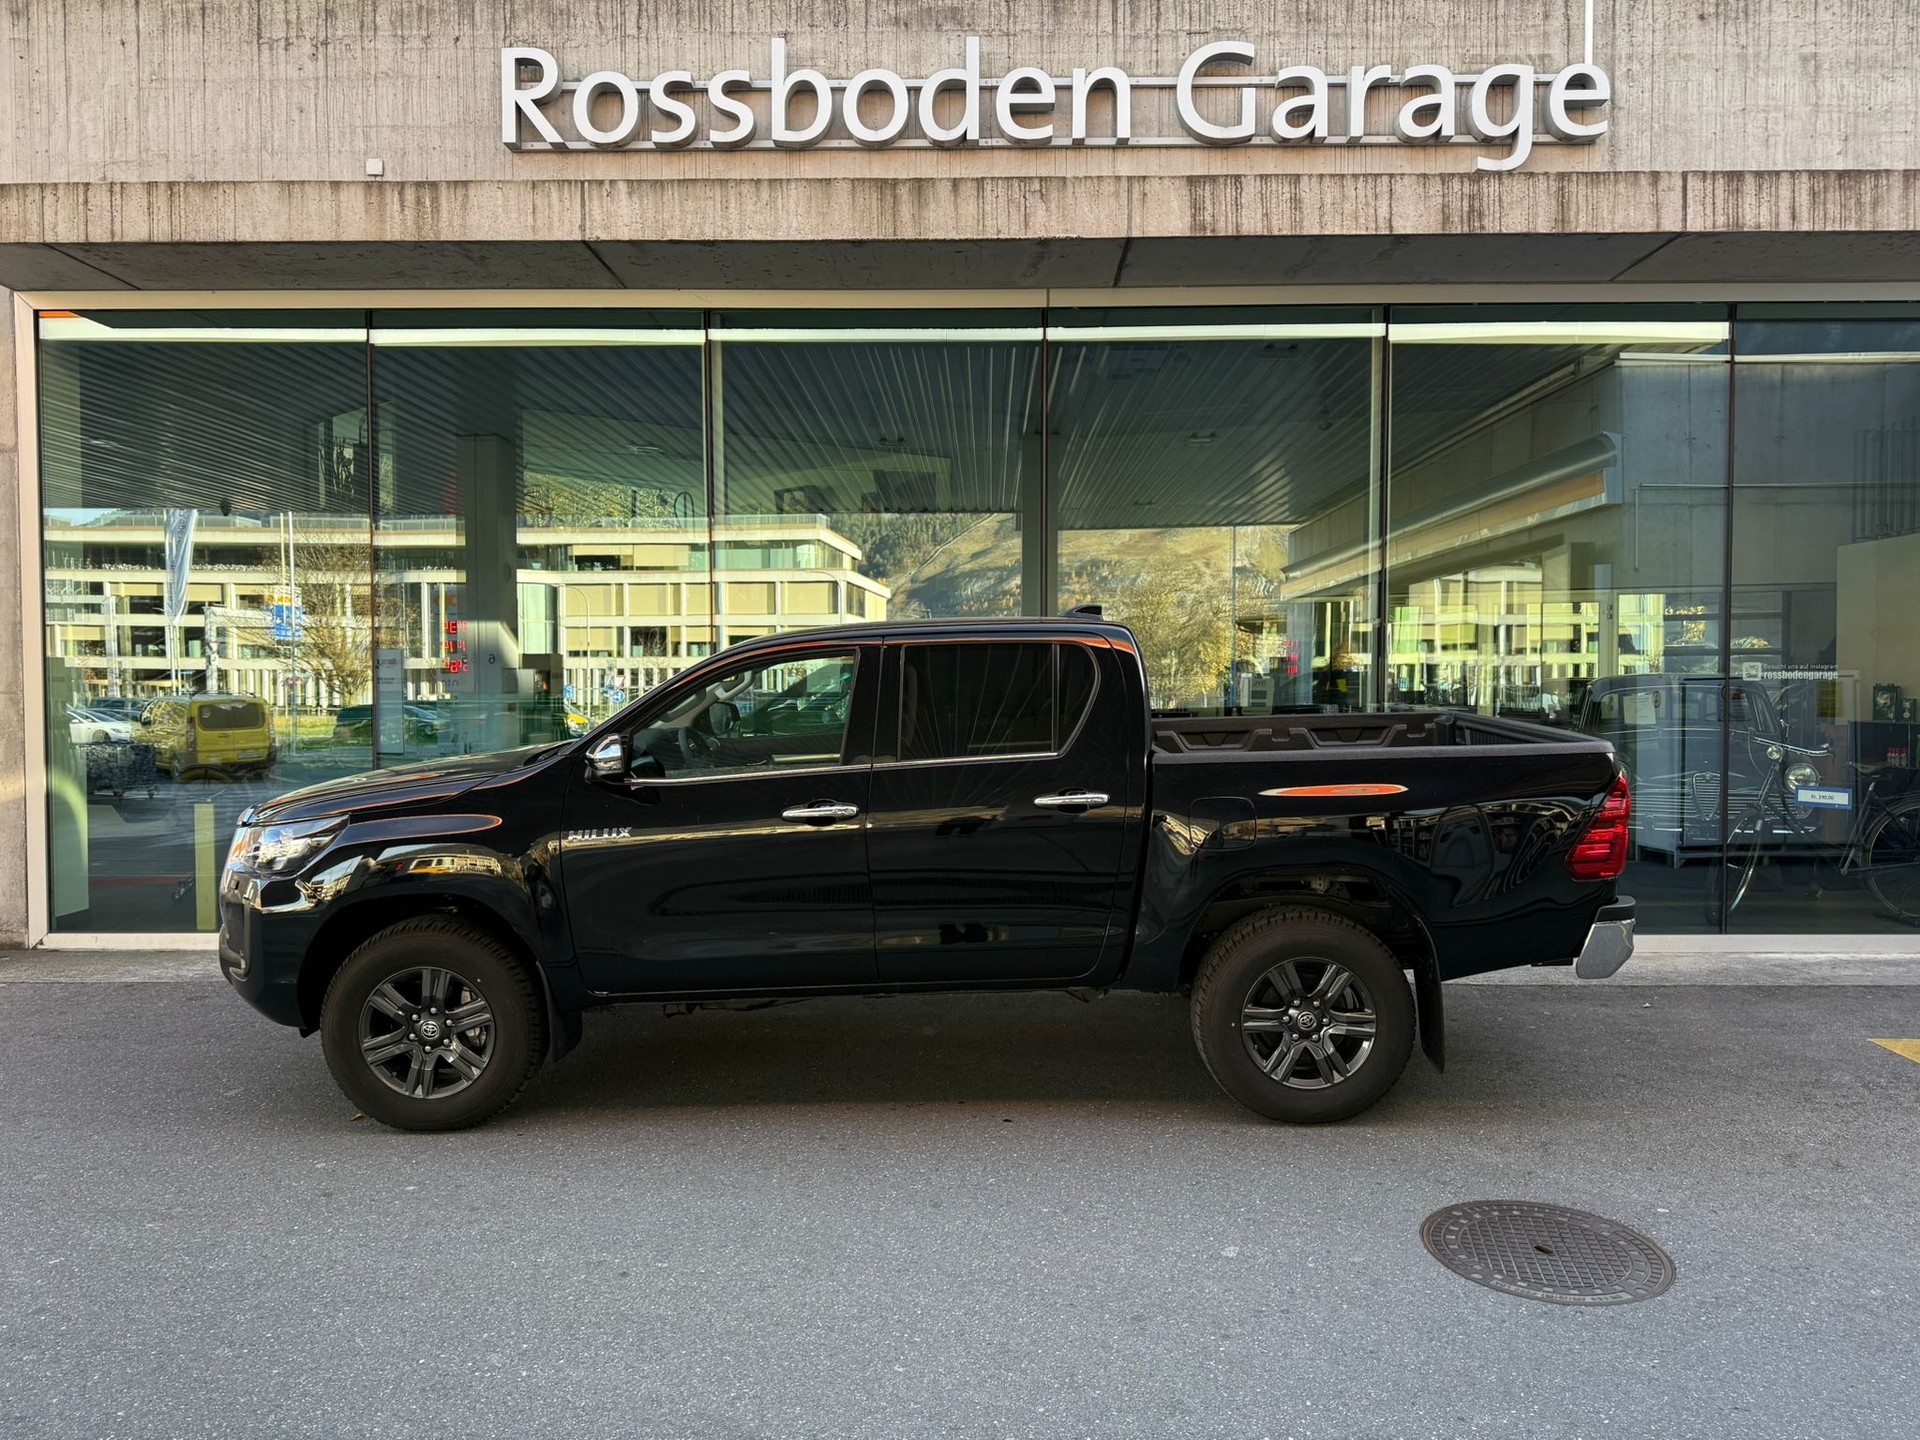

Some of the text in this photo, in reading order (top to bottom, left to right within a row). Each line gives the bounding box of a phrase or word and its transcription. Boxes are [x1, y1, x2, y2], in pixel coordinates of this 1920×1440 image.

[501, 37, 1611, 171] Rossboden Garage
[1763, 670, 1839, 680] rossbodengarage
[568, 827, 632, 840] HILUX
